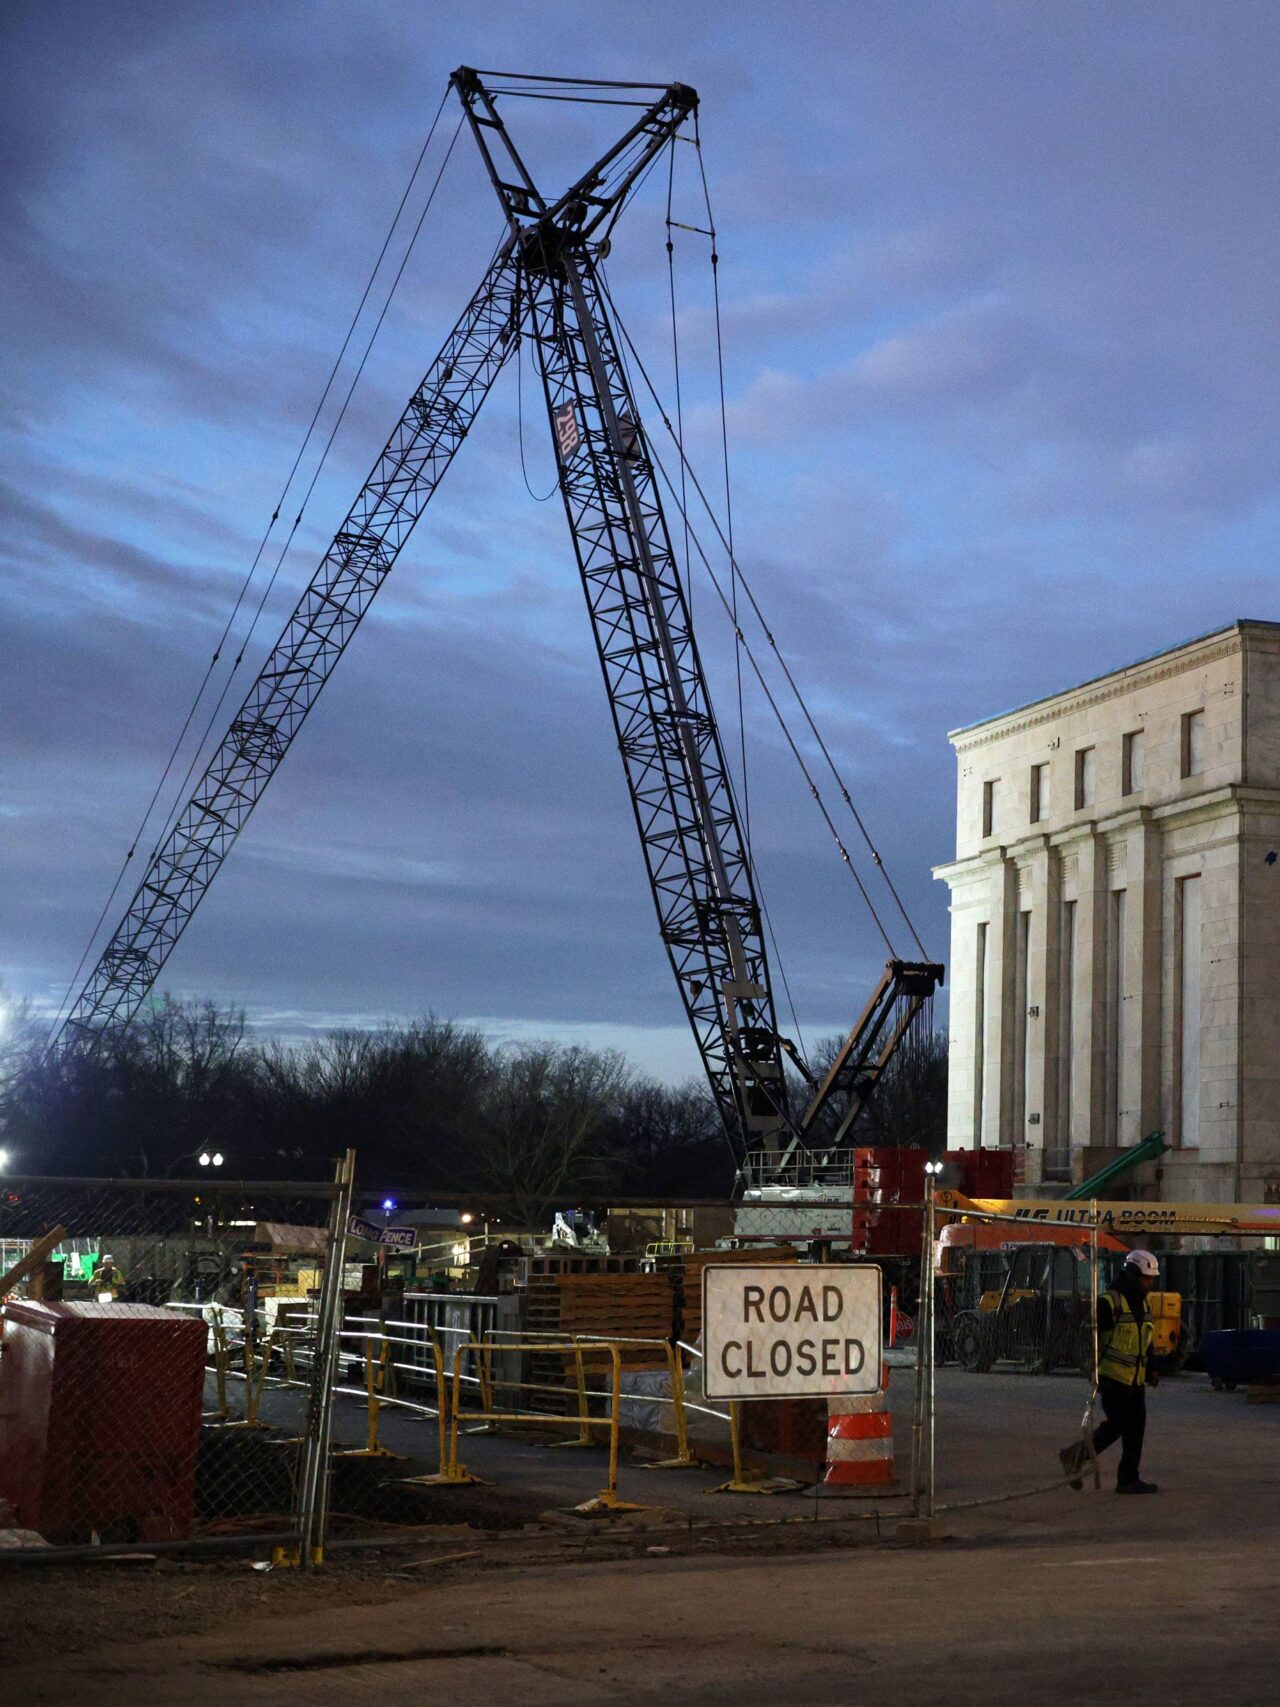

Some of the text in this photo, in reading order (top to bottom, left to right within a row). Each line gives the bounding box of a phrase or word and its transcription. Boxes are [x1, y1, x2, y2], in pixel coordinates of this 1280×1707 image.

[556, 405, 578, 456] 298
[378, 1229, 413, 1245] FENCE
[743, 1285, 843, 1323] ROAD
[721, 1339, 865, 1378] CLOSED
